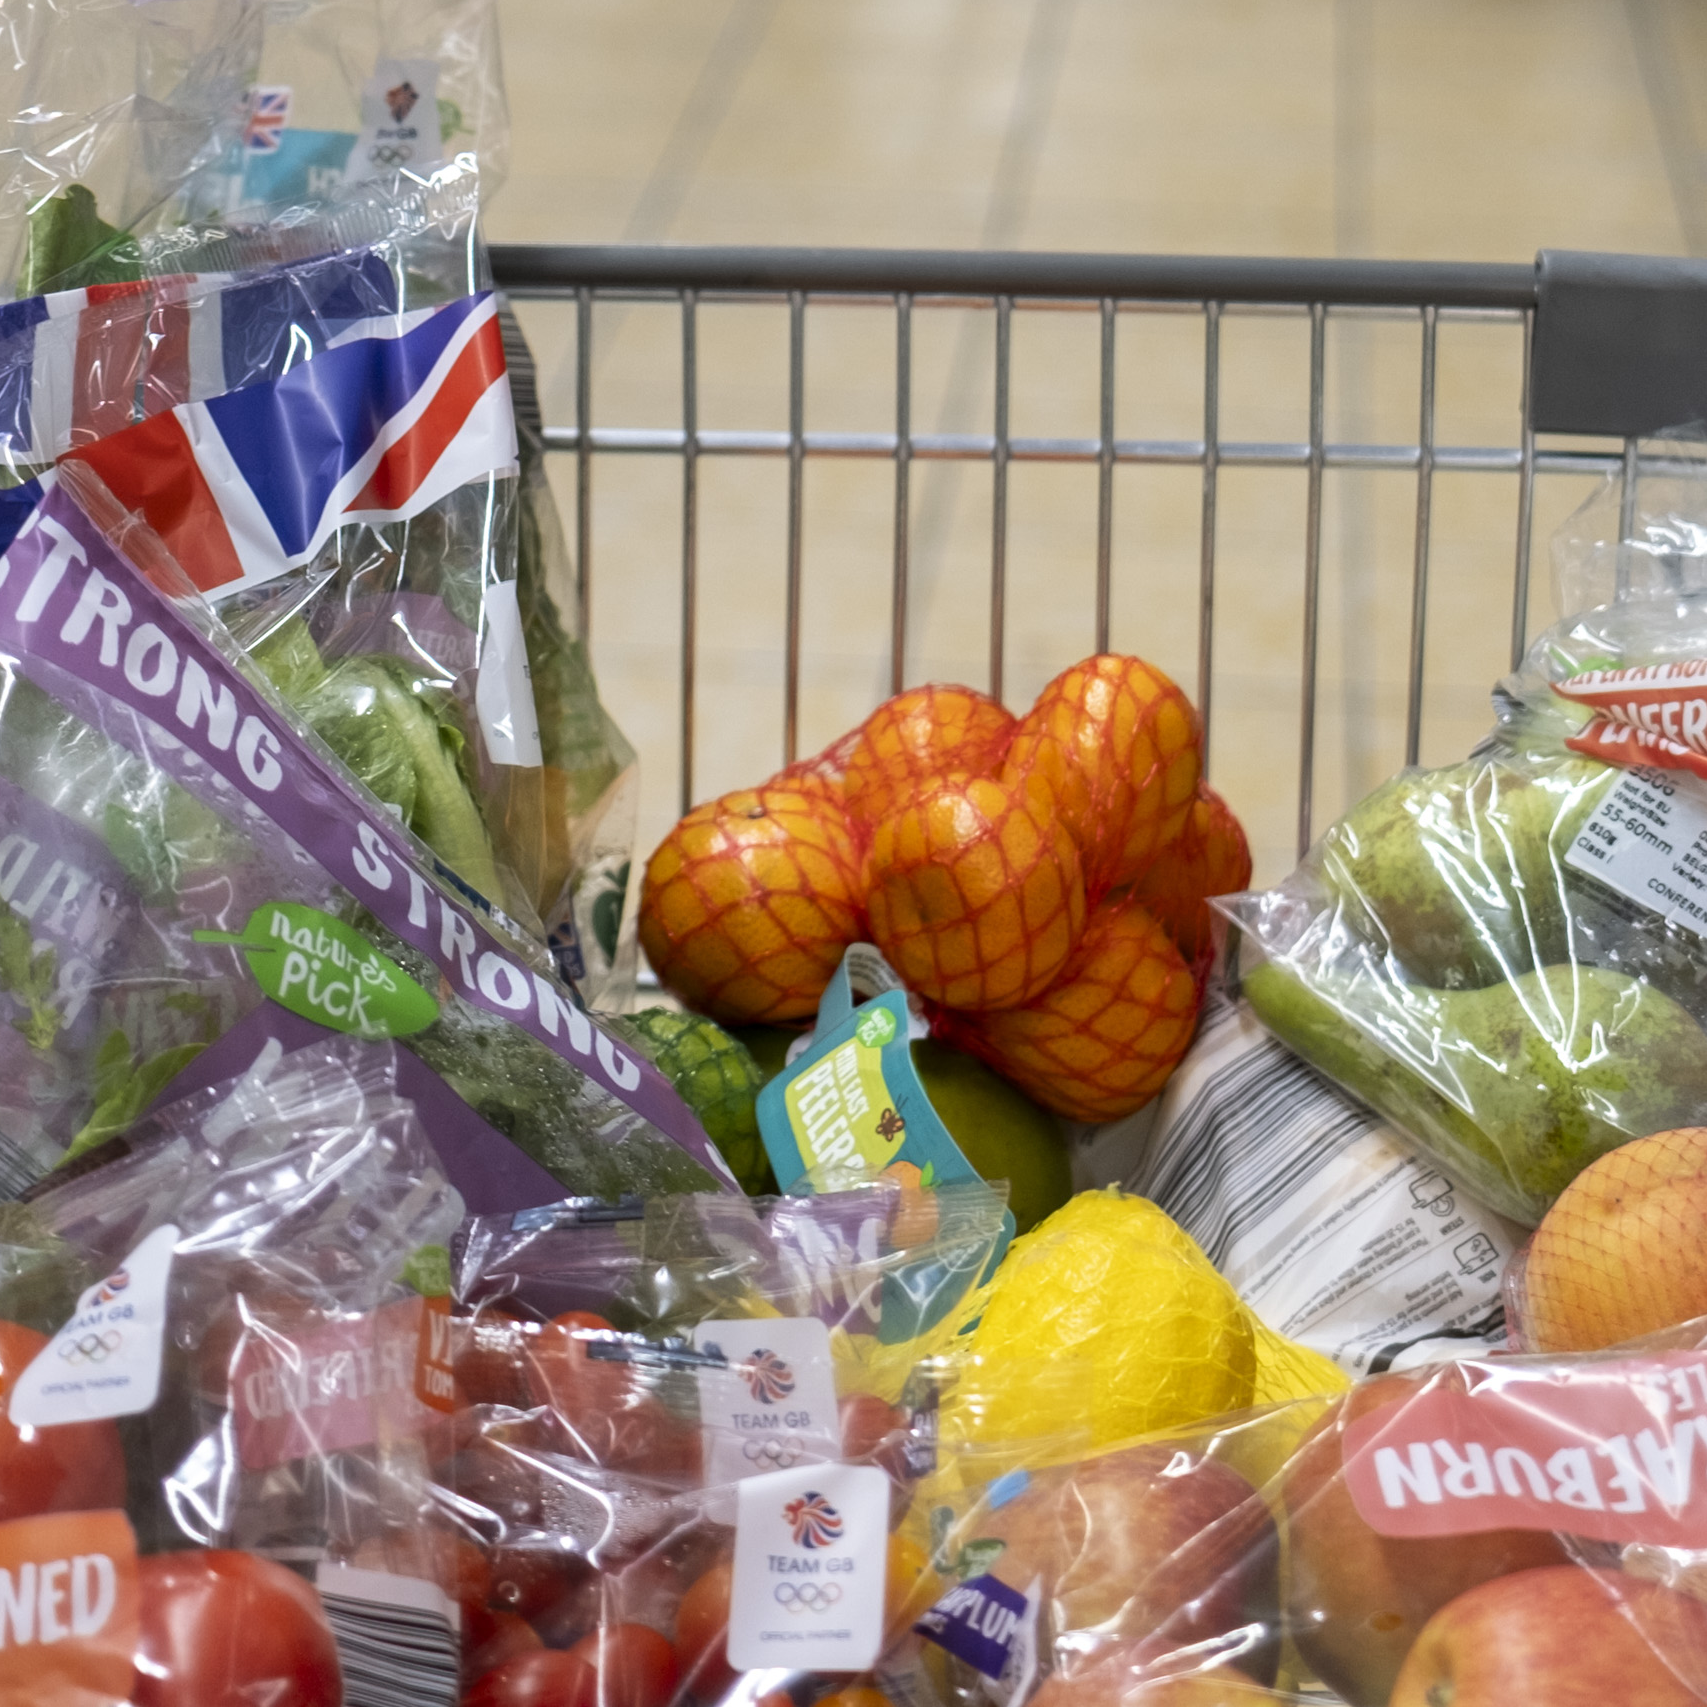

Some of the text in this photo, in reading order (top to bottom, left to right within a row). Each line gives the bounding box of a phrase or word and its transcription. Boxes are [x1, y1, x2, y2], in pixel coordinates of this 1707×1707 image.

[1639, 790, 1657, 806] for
[1654, 800, 1671, 814] EU
[1599, 801, 1673, 855] 55-60mm
[1575, 835, 1606, 860] Class
[835, 1043, 871, 1122] MINI EASY
[794, 1060, 867, 1193] PEELERS
[732, 1411, 811, 1430] TEAM GB
[768, 1555, 854, 1574] TEAM GB
